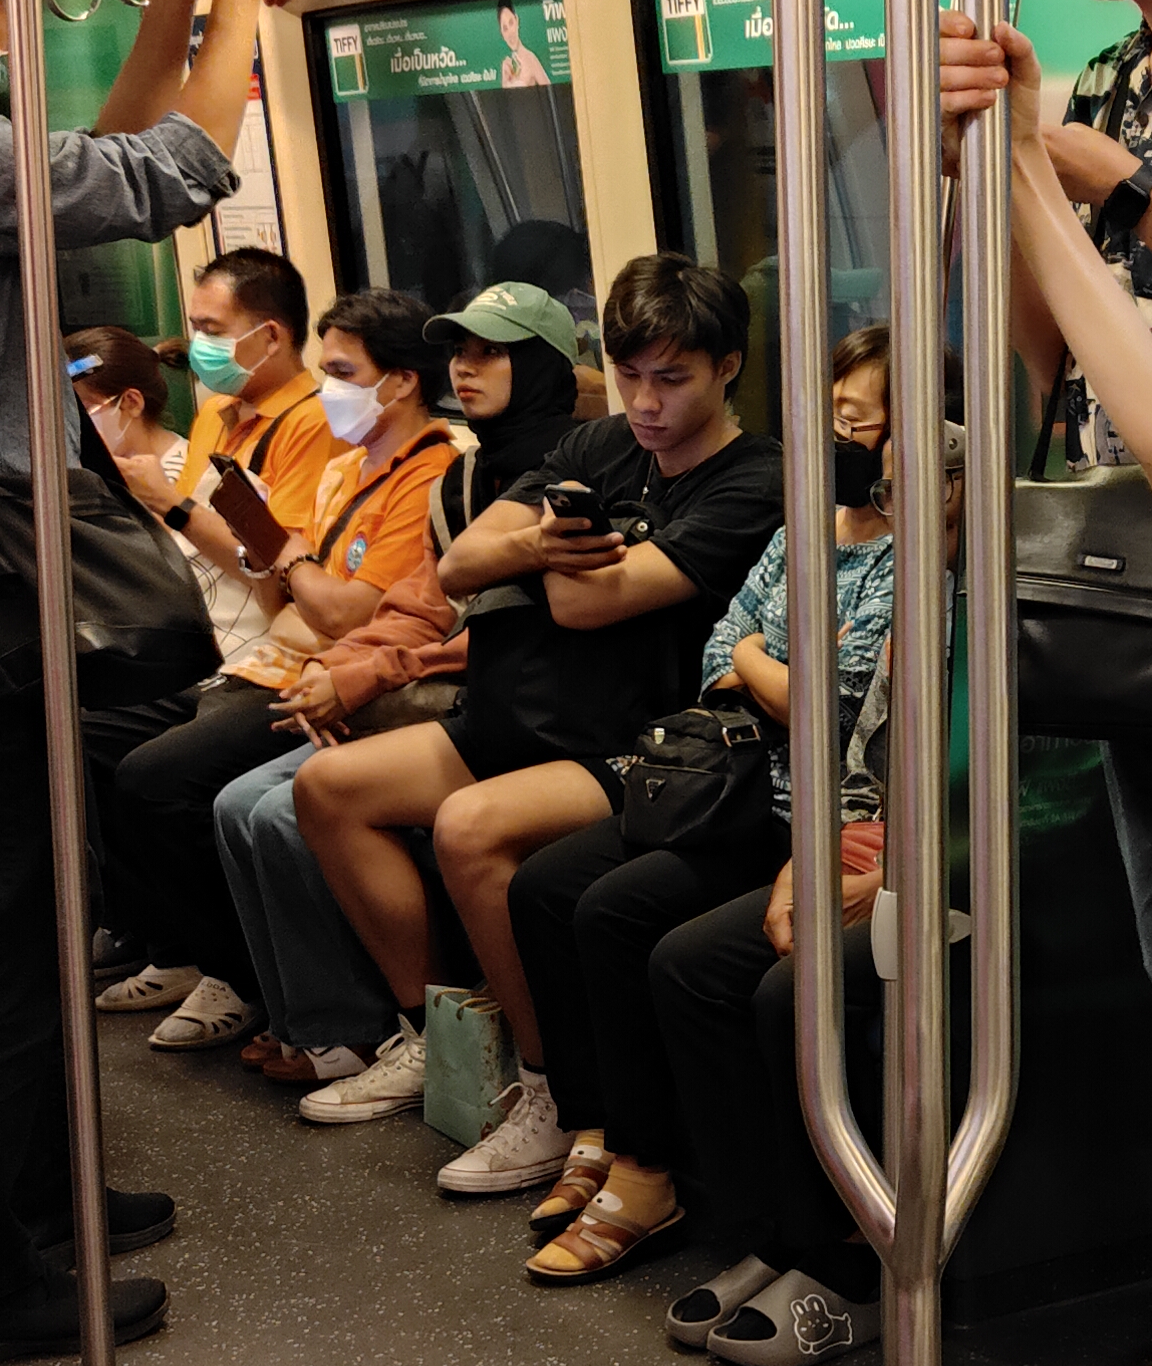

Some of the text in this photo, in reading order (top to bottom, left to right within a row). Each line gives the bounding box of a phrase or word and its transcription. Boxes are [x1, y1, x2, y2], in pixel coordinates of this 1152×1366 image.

[333, 35, 359, 54] TIFFY
[390, 46, 467, 74] เมื่อเป็นหวัด...
